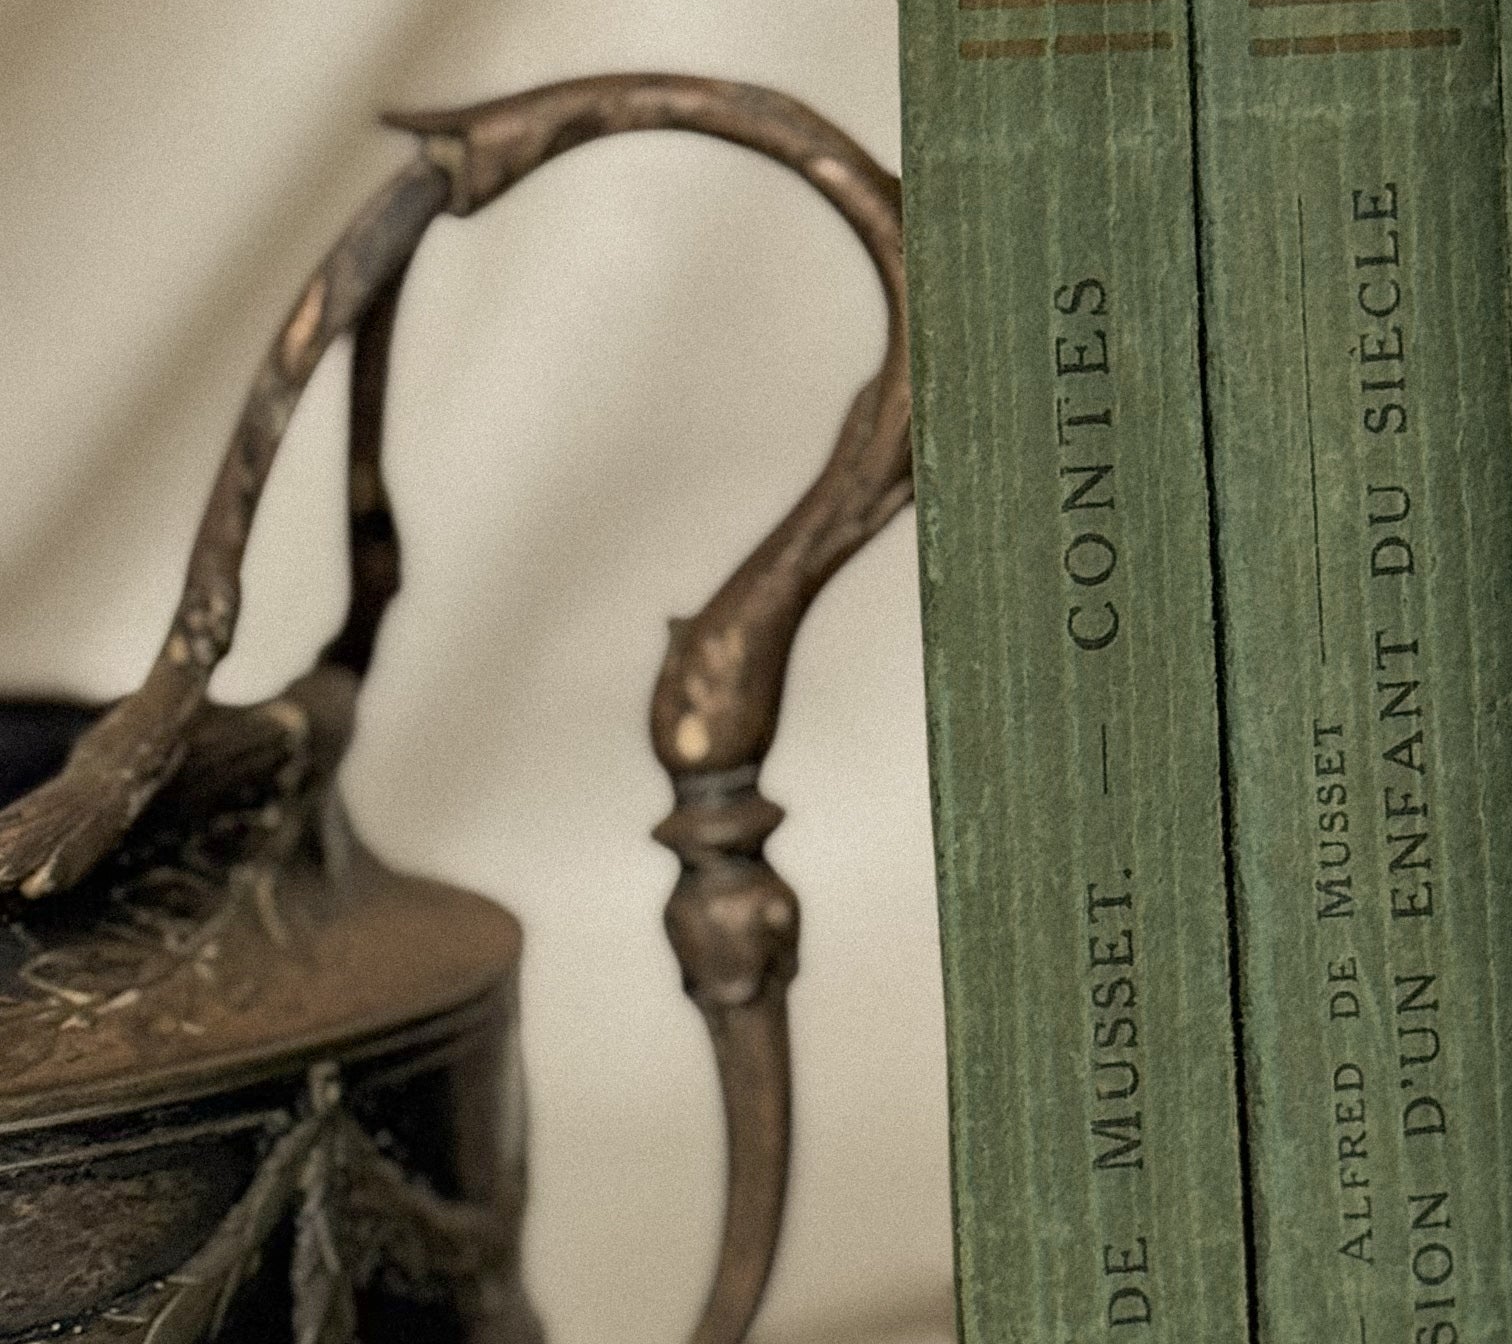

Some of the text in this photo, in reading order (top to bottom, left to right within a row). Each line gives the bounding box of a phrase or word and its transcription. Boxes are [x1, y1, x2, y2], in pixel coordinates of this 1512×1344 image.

[1349, 181, 1408, 434] SIÈCLE
[1056, 277, 1120, 652] CONTES
[1366, 484, 1414, 578] DU
[1375, 630, 1434, 921] ENFANT
[1087, 867, 1143, 1171] MUSSET.
[1314, 719, 1374, 1261] ALFRED DE MUSSET
[1395, 975, 1447, 1139] D'UN
[1104, 1237, 1153, 1328] DE
